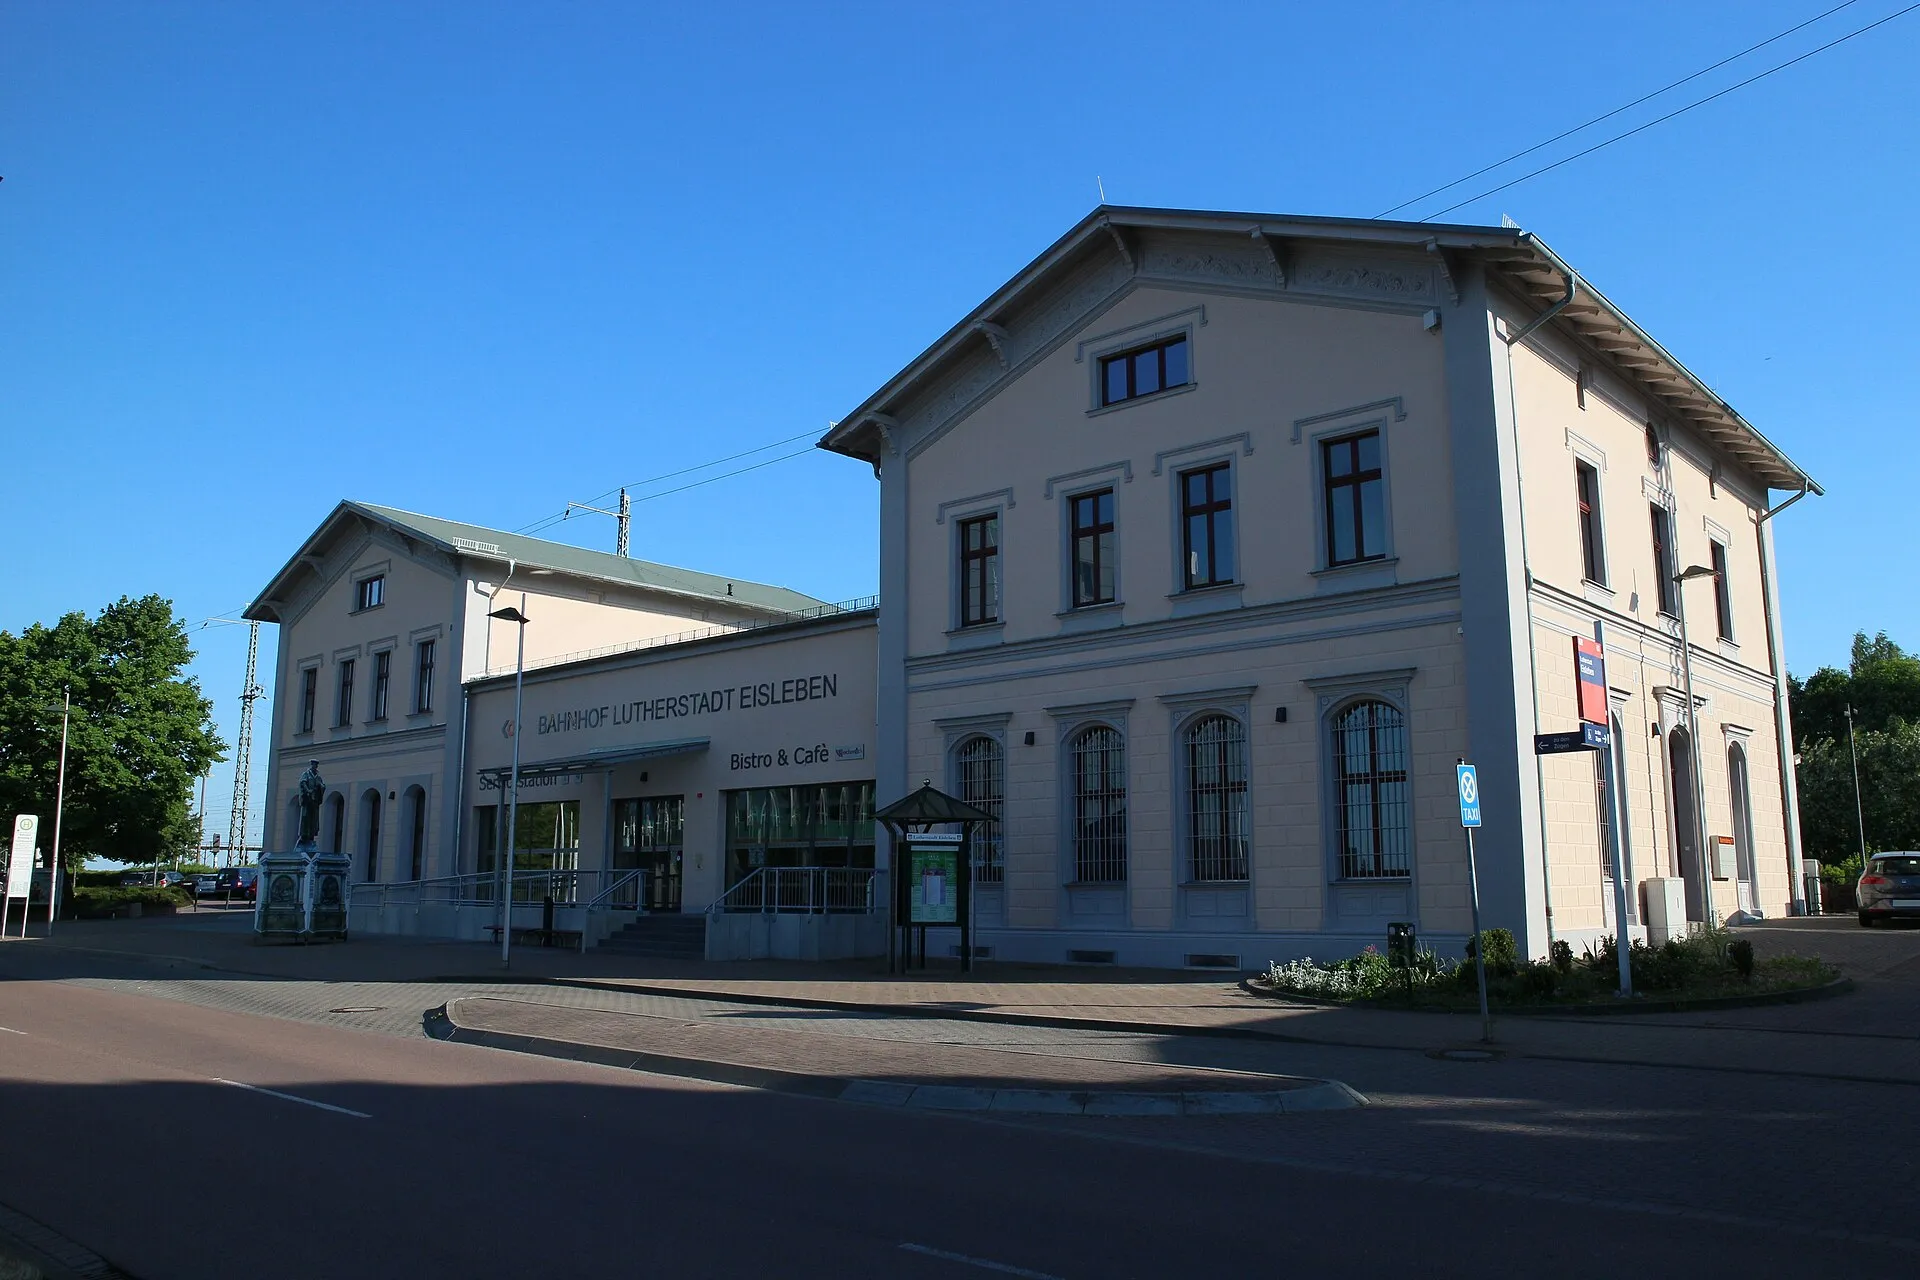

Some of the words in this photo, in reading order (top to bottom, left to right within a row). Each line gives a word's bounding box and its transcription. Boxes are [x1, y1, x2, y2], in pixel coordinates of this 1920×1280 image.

[538, 706, 610, 735] BAHNHOF
[613, 688, 735, 726] LUTHERSTADT
[740, 674, 837, 709] EISLEBEN
[730, 753, 772, 770] Bistro
[777, 749, 789, 766] &
[1463, 807, 1480, 821] TAXI
